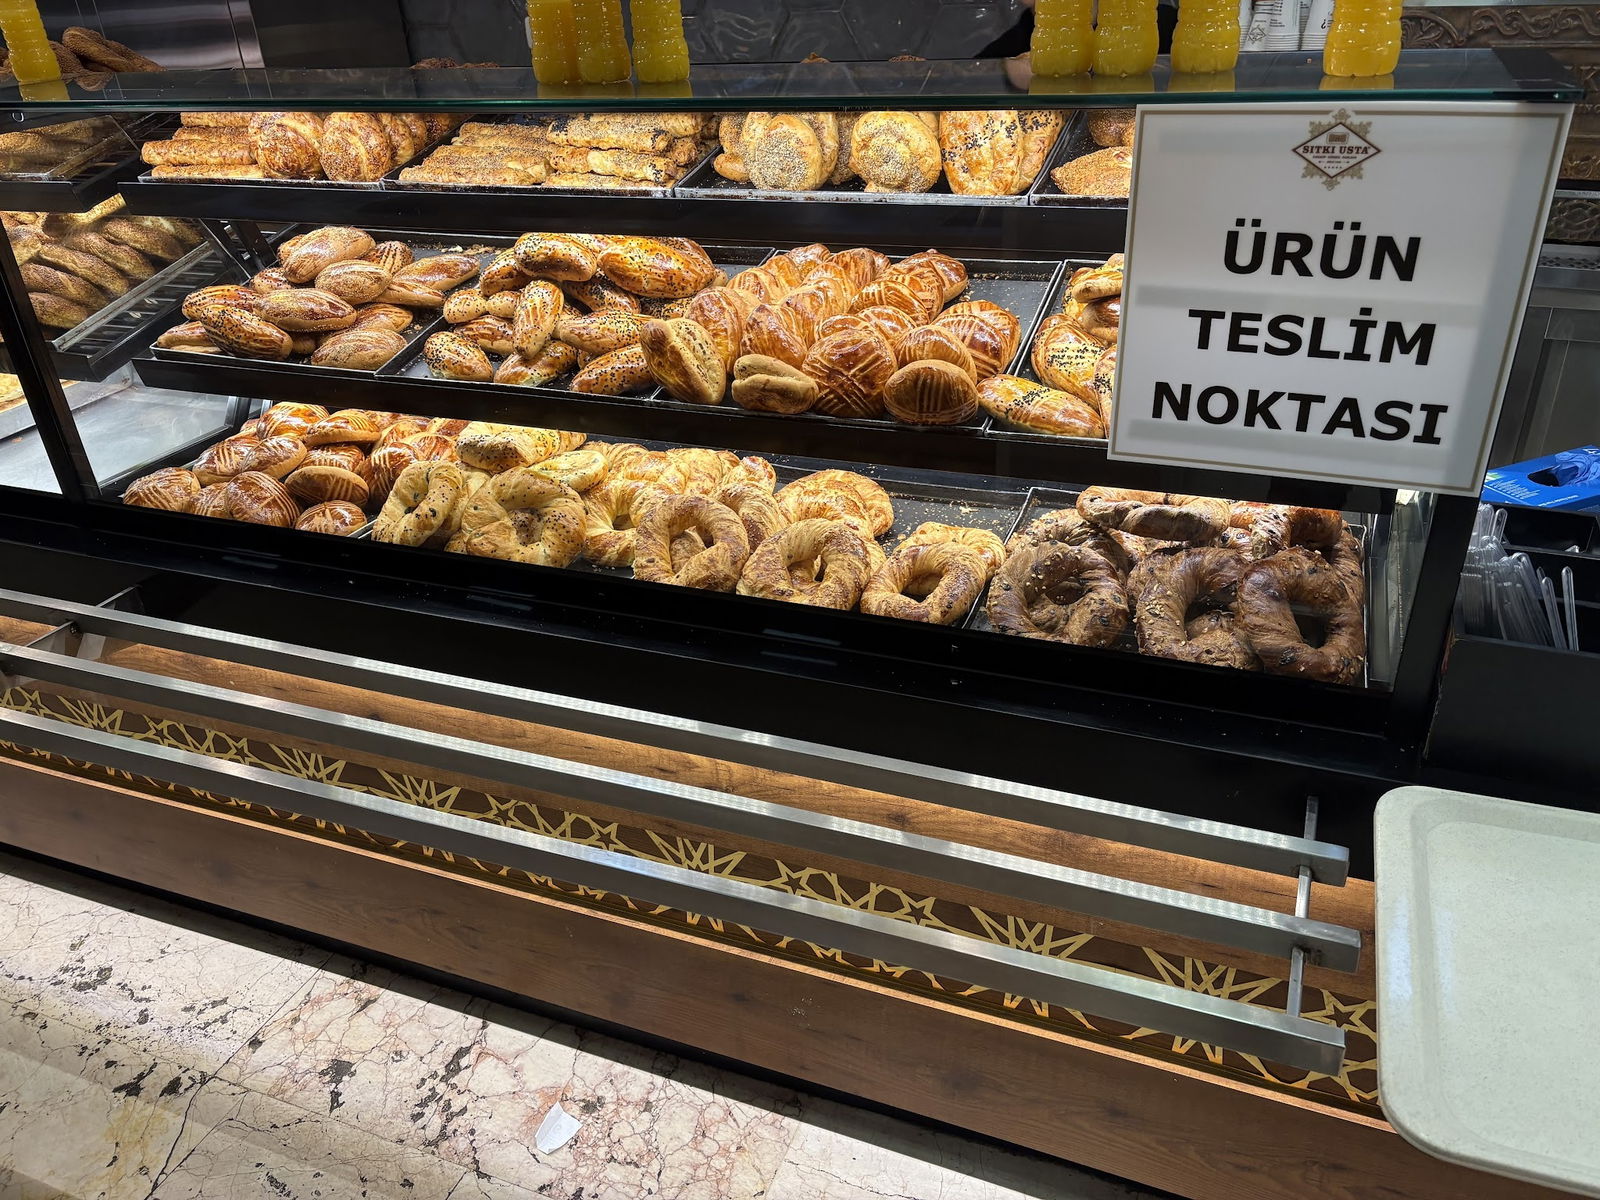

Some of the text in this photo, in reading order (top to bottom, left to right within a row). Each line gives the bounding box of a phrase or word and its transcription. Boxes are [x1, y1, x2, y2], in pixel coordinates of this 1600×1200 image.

[1302, 145, 1369, 155] SITKI USTA
[1223, 218, 1421, 282] ÜRÜN
[1188, 307, 1436, 366] TESLİM
[1151, 381, 1449, 445] NOKTASI
